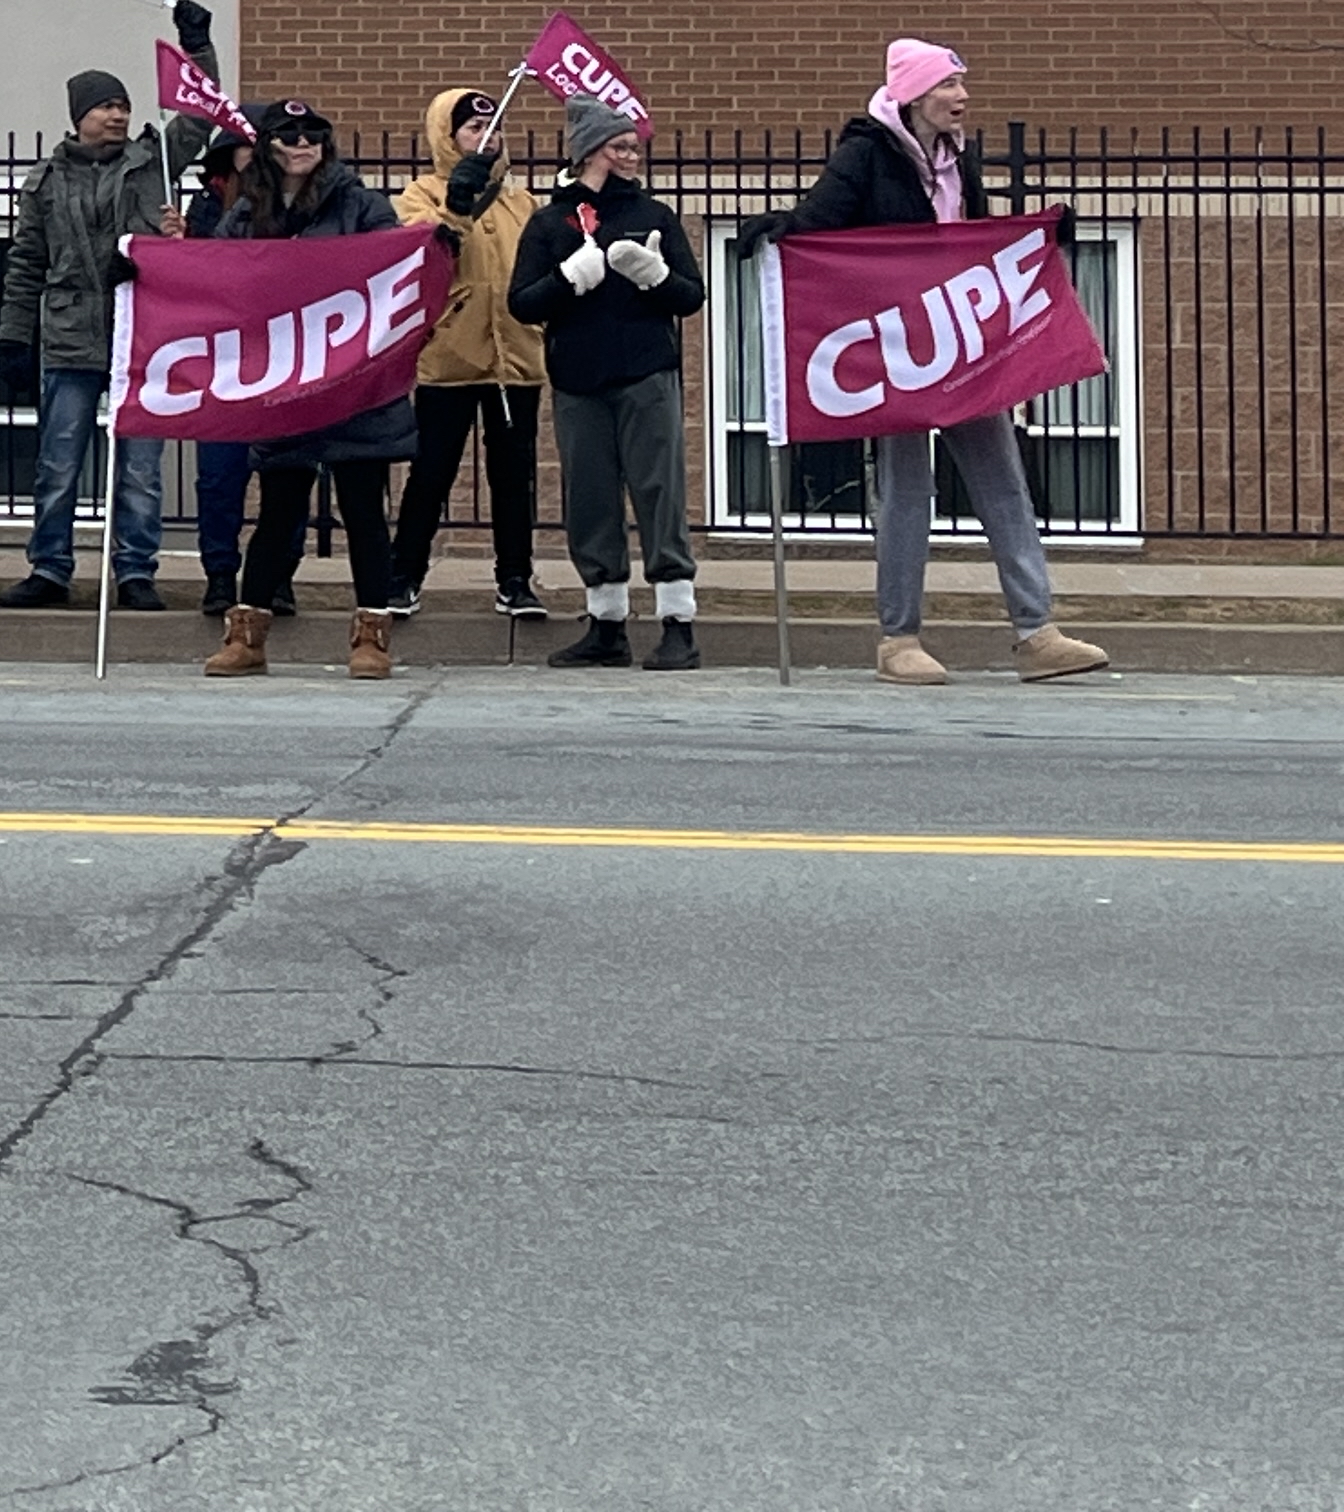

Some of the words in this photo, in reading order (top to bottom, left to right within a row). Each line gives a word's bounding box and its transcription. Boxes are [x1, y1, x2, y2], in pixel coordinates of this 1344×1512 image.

[561, 42, 649, 121] CUPE
[138, 245, 426, 417] CUPE
[806, 227, 1053, 418] CUPE
